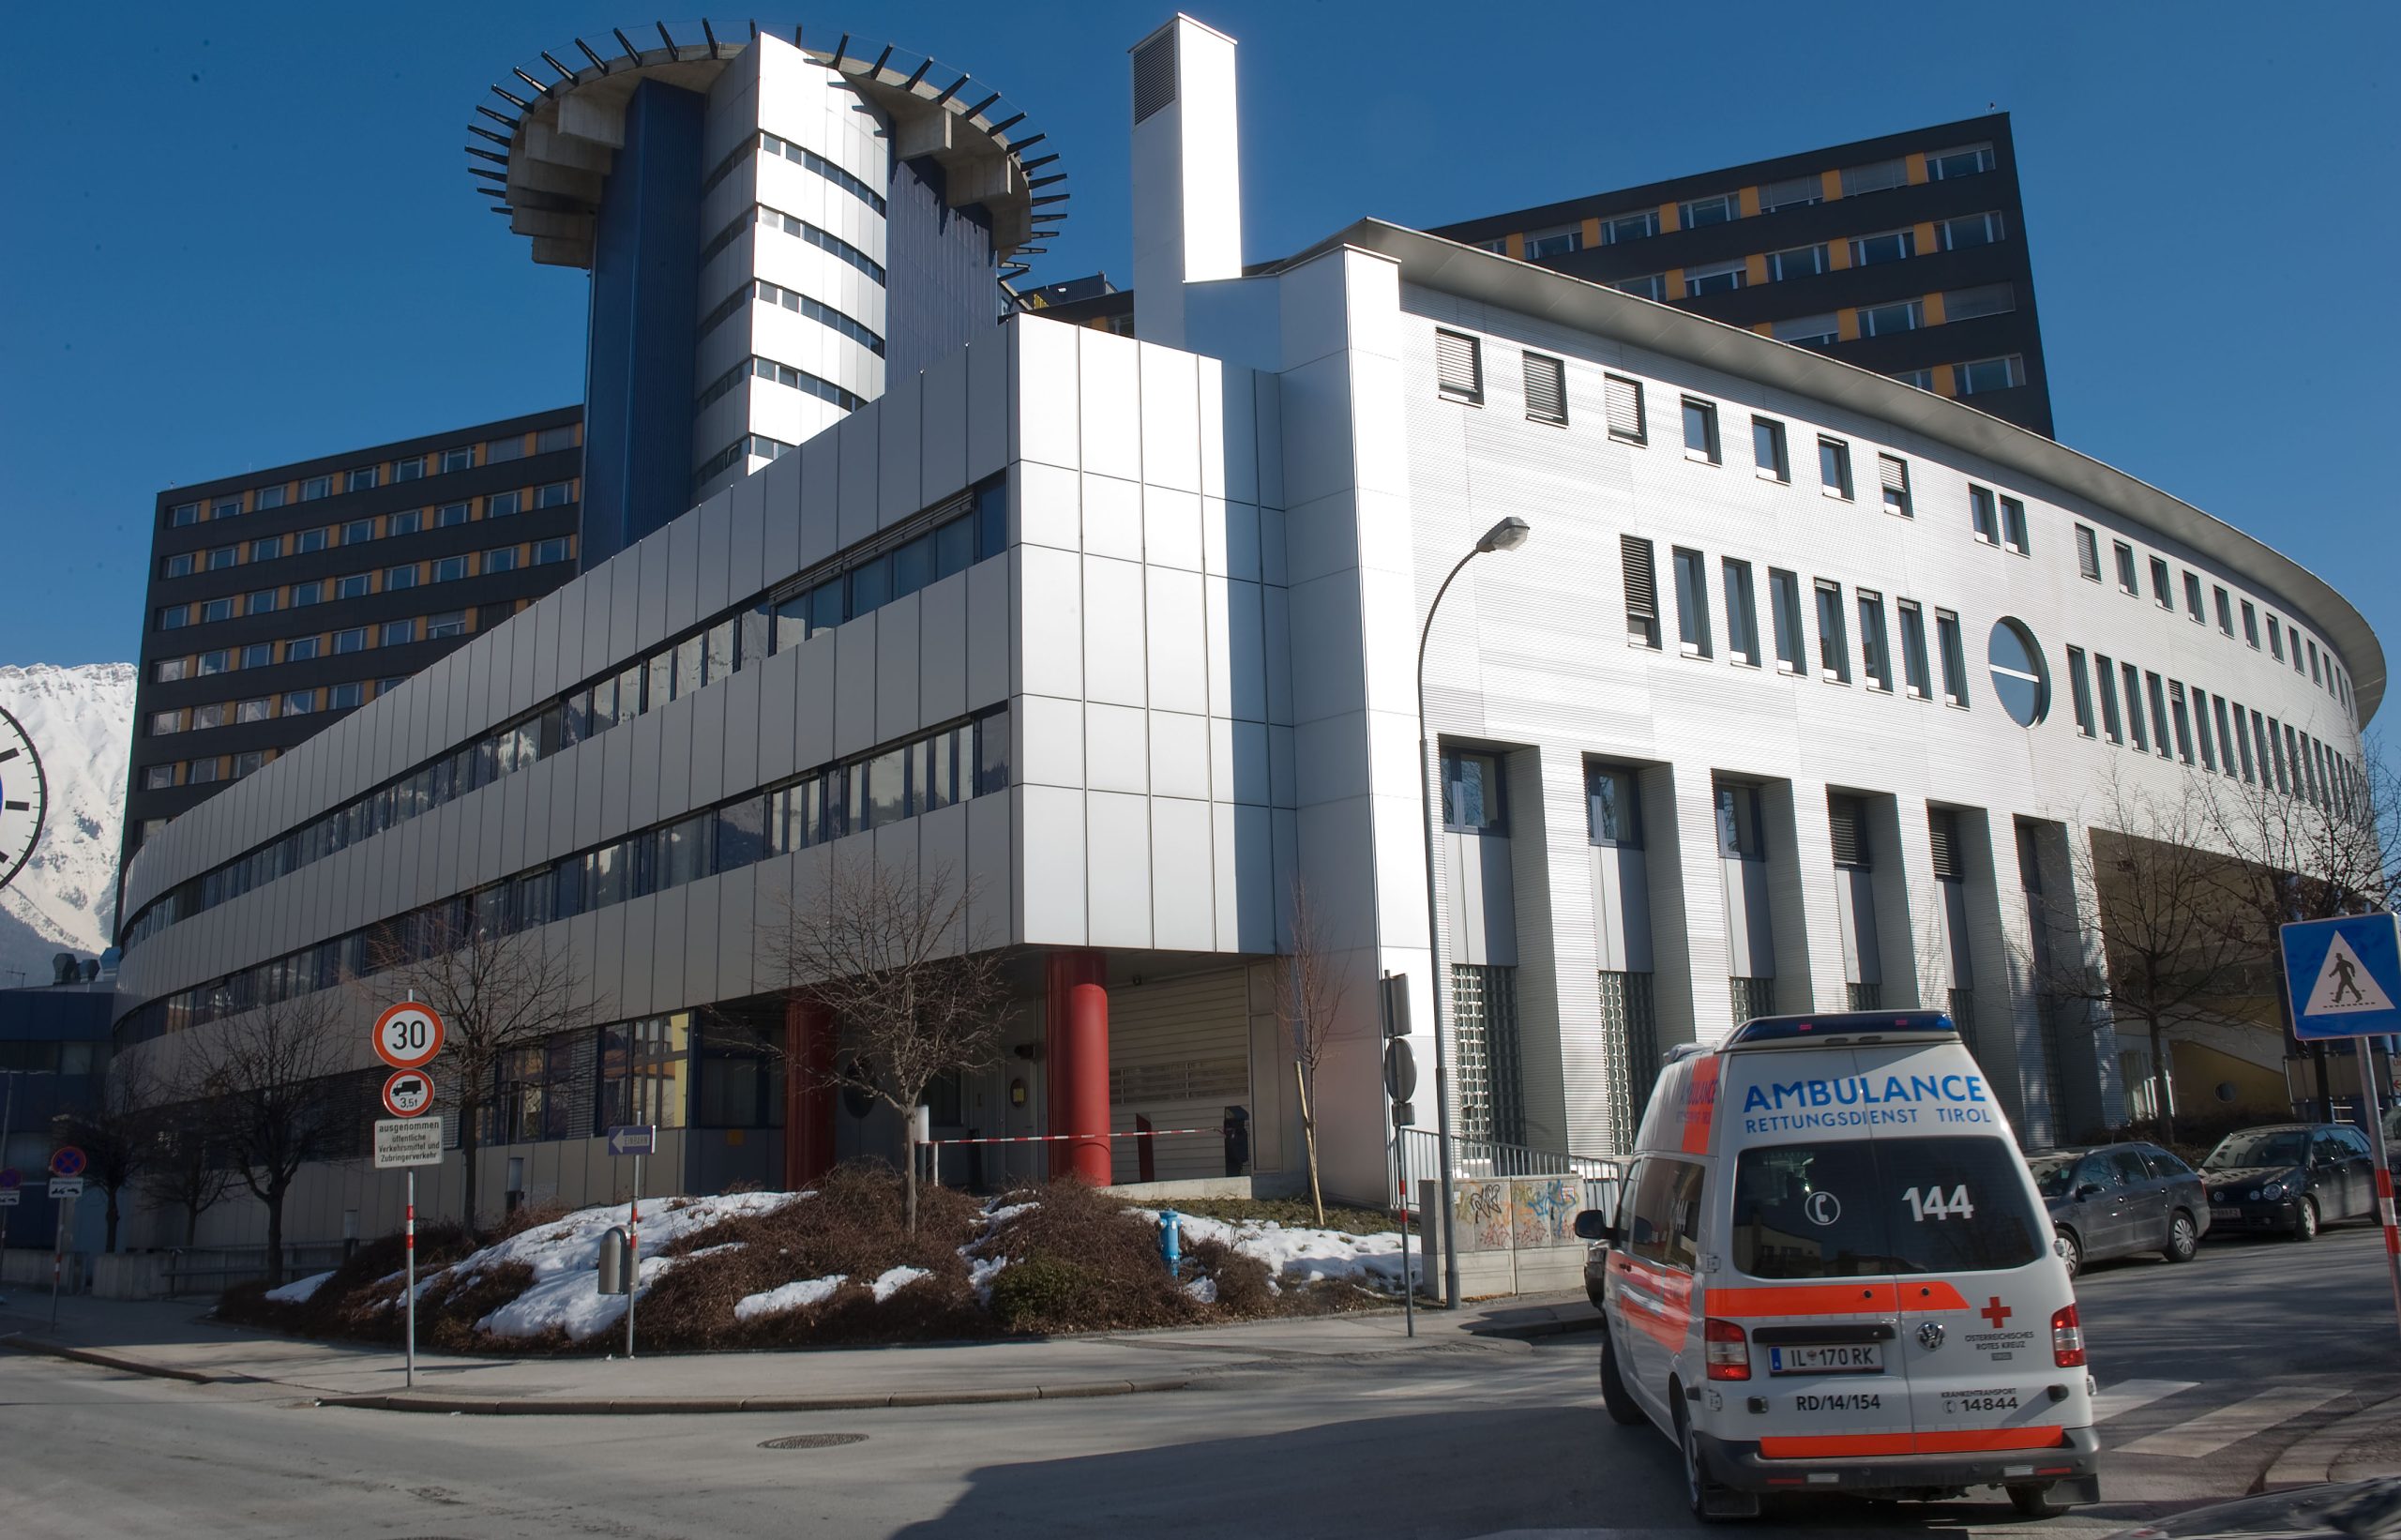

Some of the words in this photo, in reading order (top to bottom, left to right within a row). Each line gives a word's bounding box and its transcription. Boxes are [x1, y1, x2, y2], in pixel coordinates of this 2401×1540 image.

[392, 1020, 426, 1049] 30
[1743, 1075, 1986, 1113] AMBULANCE
[400, 1097, 418, 1109] 3,5t
[379, 1122, 440, 1134] ausgenommen
[1745, 1109, 1918, 1134] RETTUNGSDIENST
[1936, 1109, 1991, 1124] TIROL
[379, 1142, 426, 1153] Verkehrsmittel
[428, 1140, 440, 1150] und
[381, 1151, 437, 1163] Zubringerverkehr
[1901, 1184, 1974, 1222] 144
[1976, 1342, 1999, 1351] ROTES
[1820, 1348, 1848, 1366] 170
[1852, 1347, 1874, 1365] RK
[1796, 1394, 1881, 1412] RD/14/154
[1960, 1396, 2018, 1412] 14844
